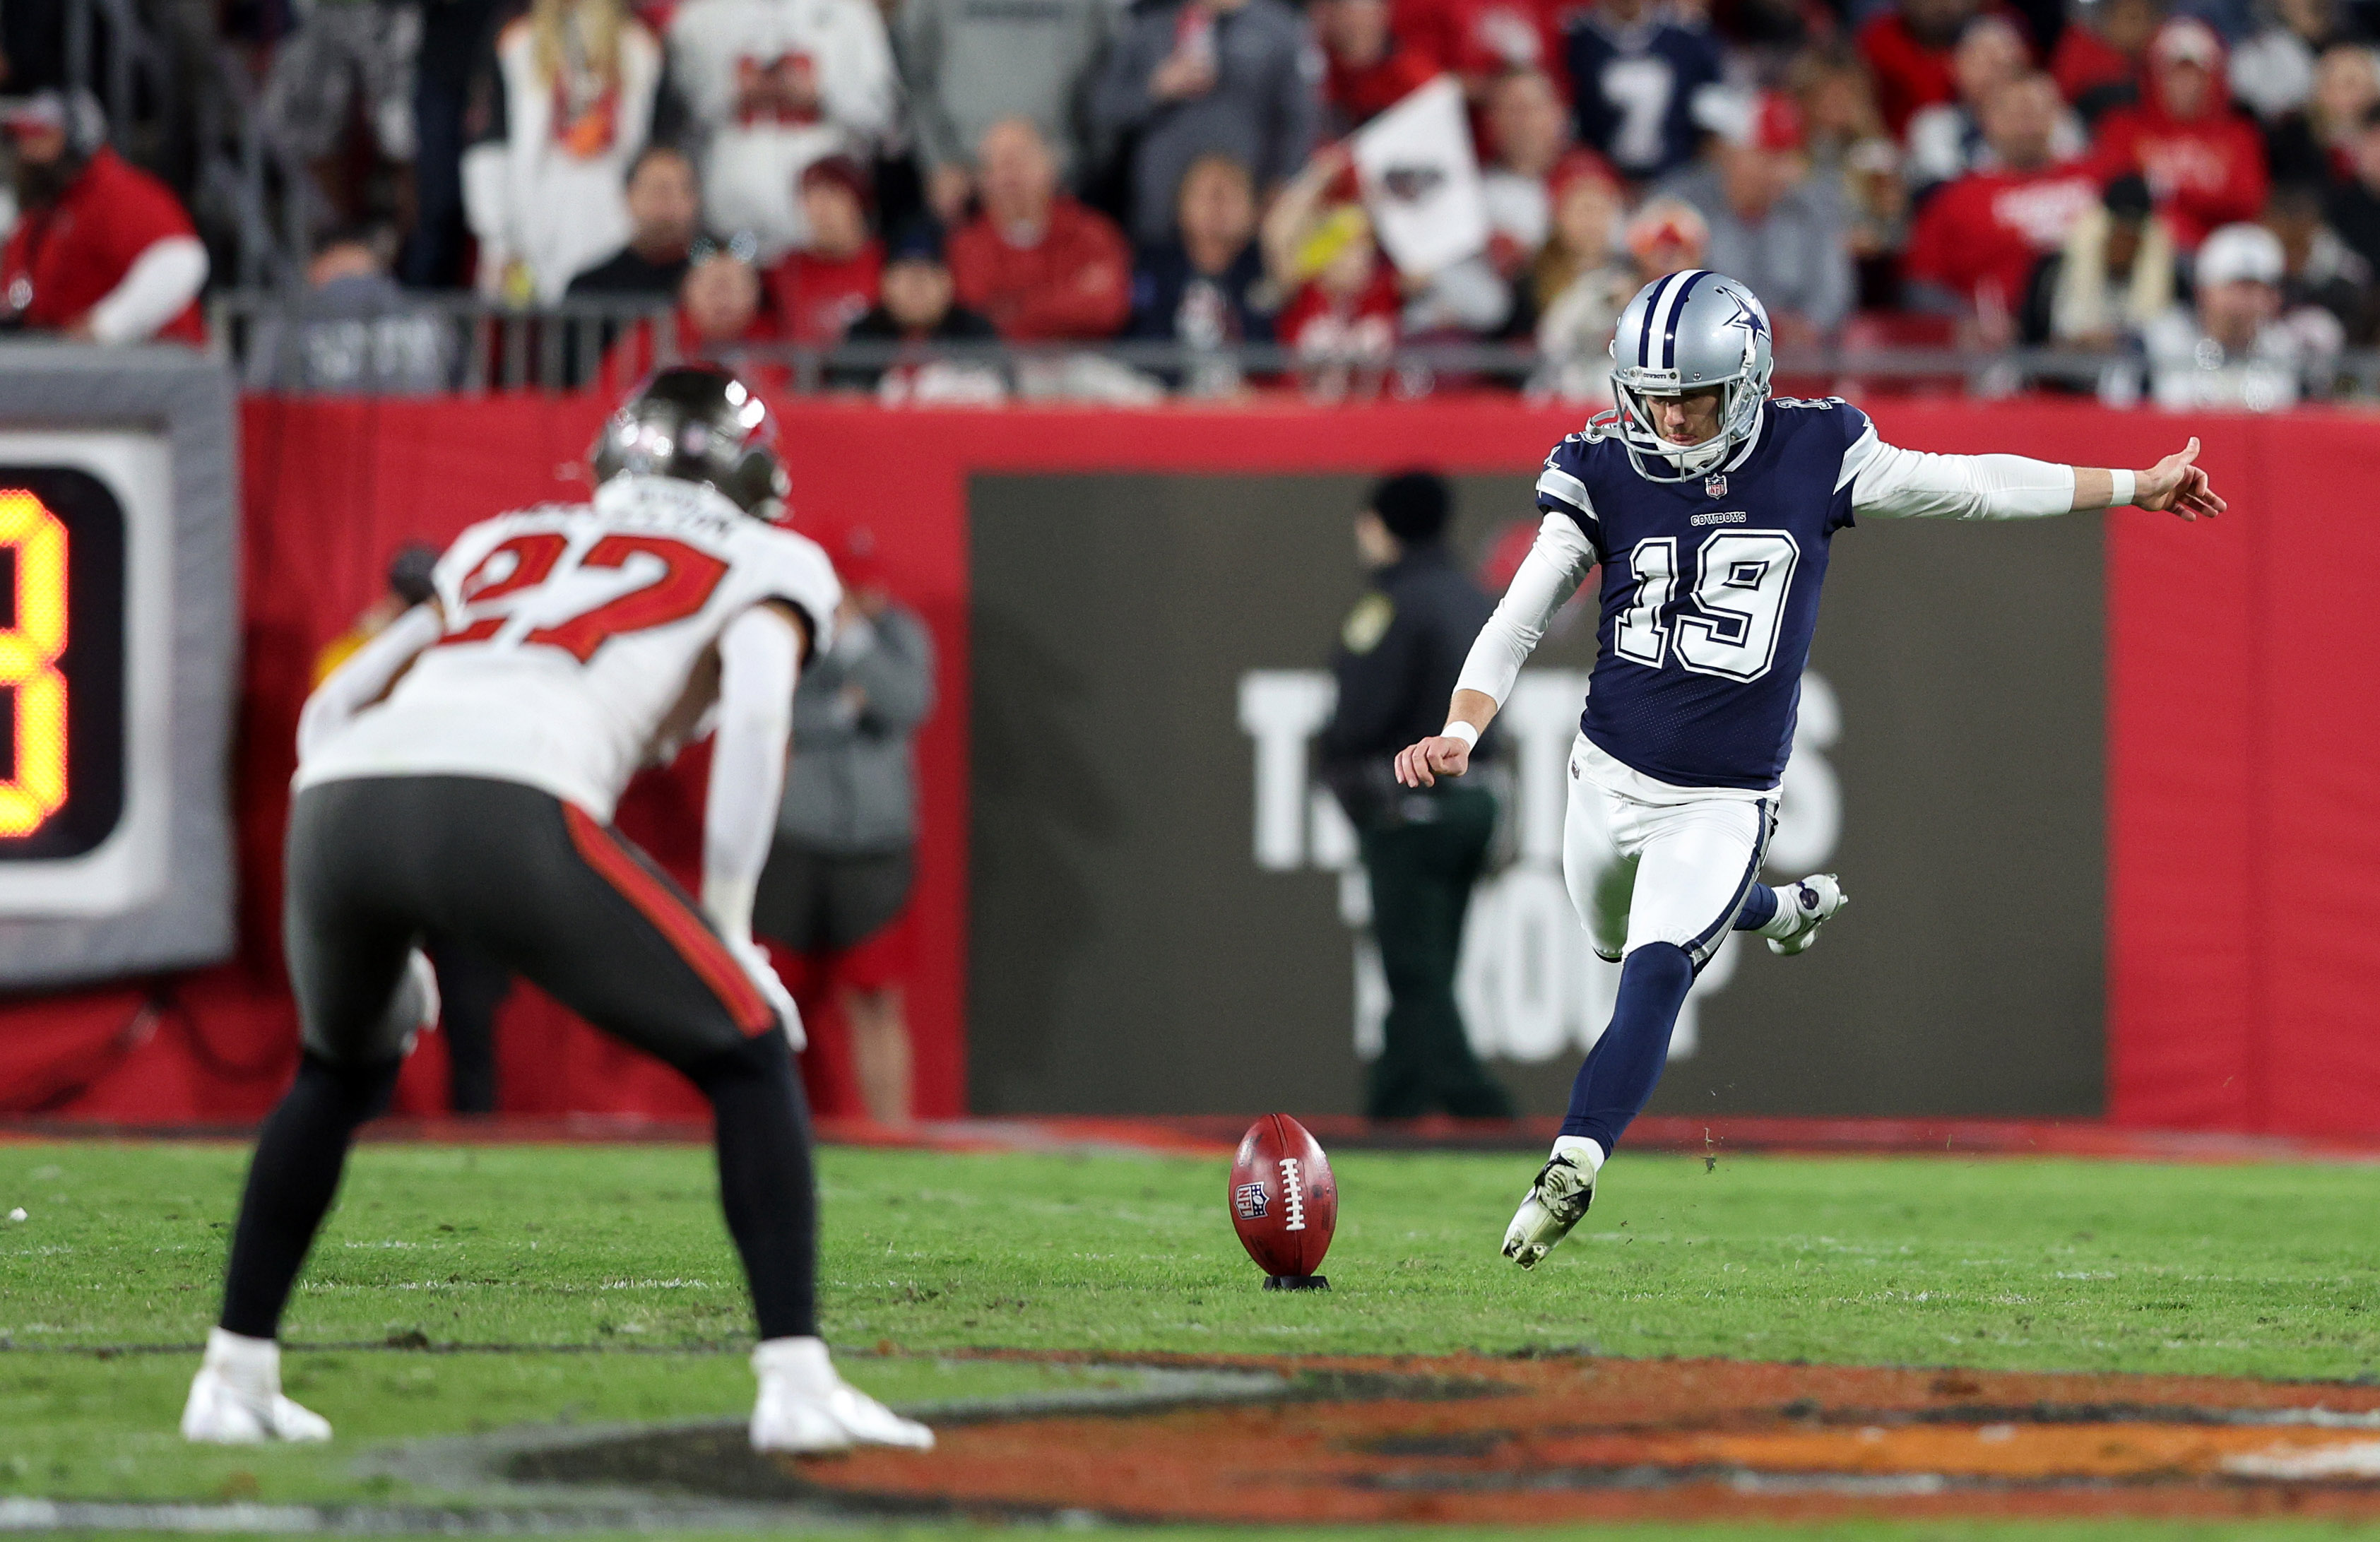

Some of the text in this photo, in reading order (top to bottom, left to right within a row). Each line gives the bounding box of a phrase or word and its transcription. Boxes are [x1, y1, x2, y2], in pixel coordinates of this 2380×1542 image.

[1599, 59, 1675, 167] 7
[1710, 485, 1724, 494] NFL
[1691, 511, 1746, 526] COWBOYS
[1615, 528, 1800, 684] 19
[1238, 1190, 1253, 1216] NFL
